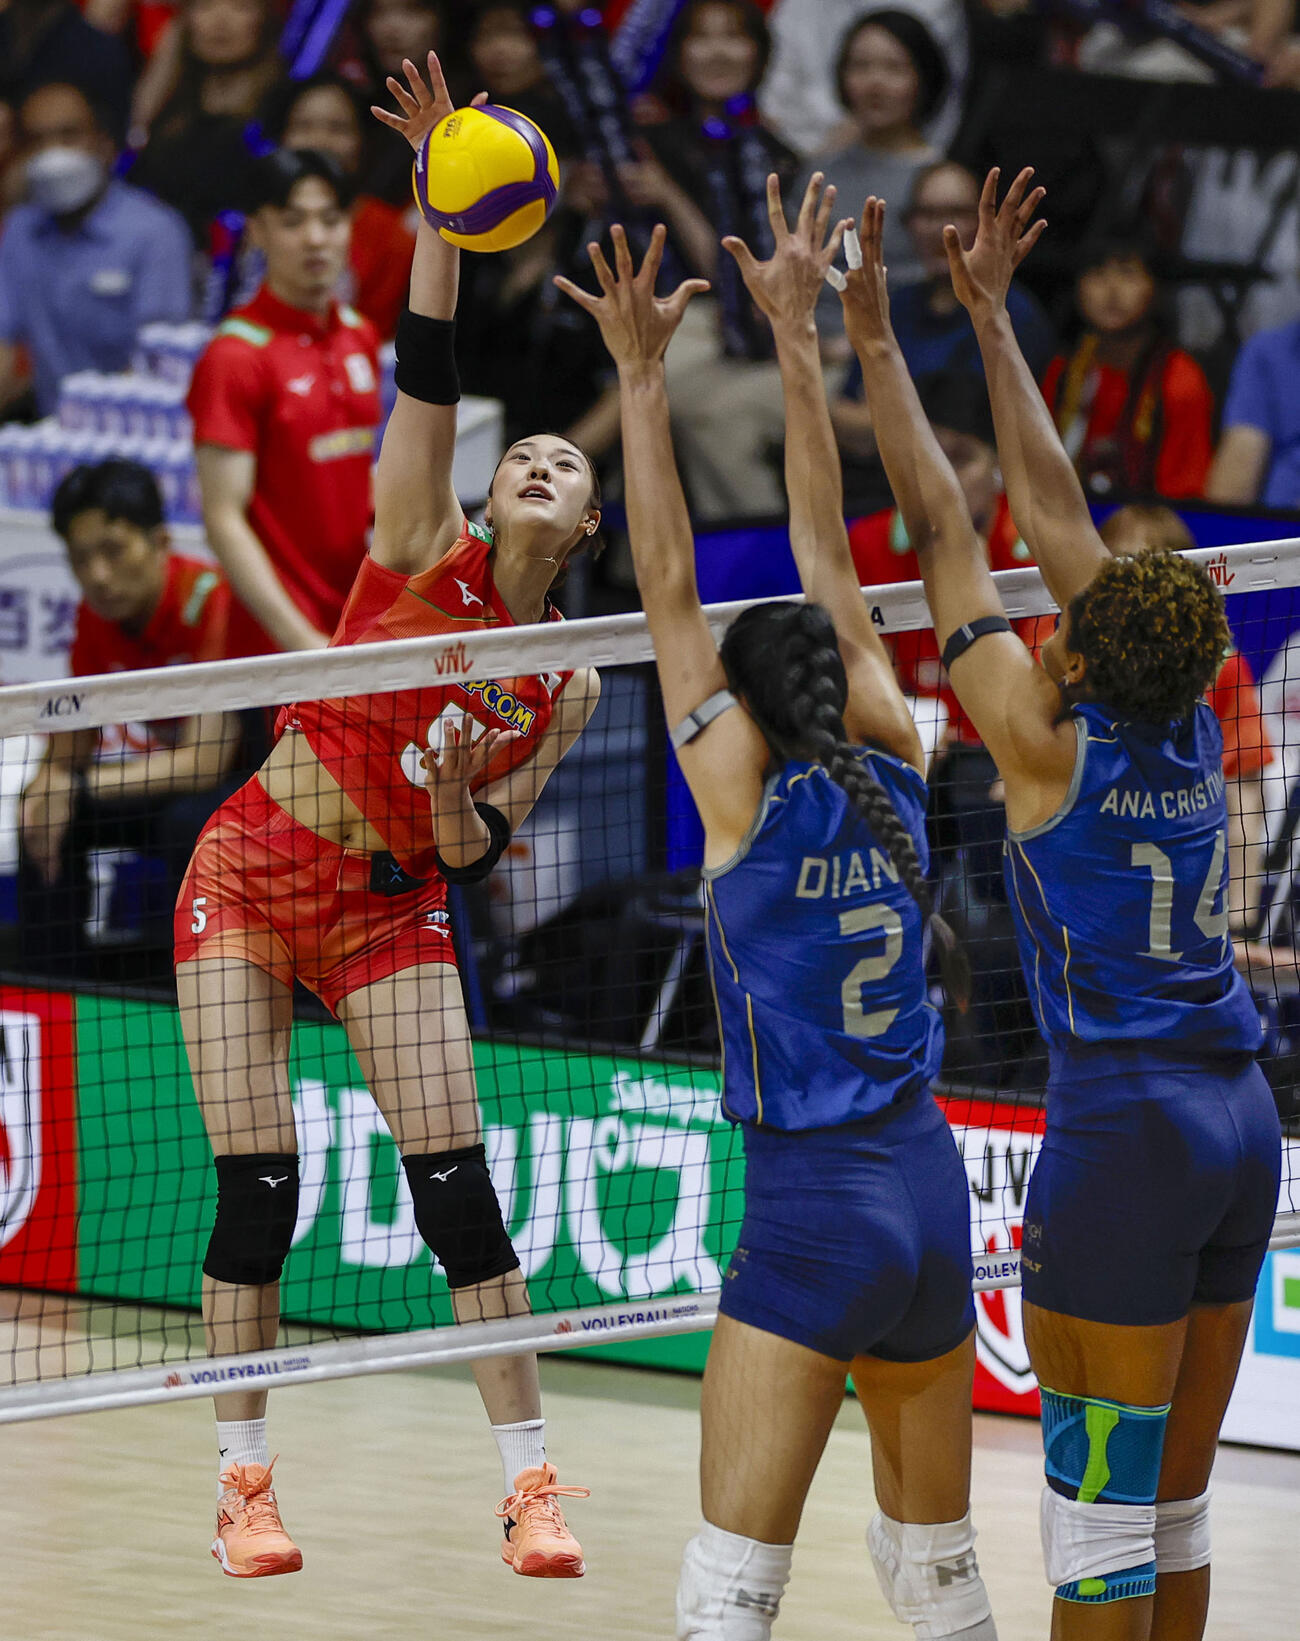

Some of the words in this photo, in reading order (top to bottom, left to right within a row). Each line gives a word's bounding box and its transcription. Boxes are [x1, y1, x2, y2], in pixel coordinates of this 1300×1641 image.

[1100, 787, 1156, 819] ANA
[795, 836, 913, 900] DIAN
[191, 896, 208, 935] 5
[1131, 829, 1230, 961] 14
[838, 902, 904, 1039] 2
[190, 1361, 281, 1385] VOLLEYBALL
